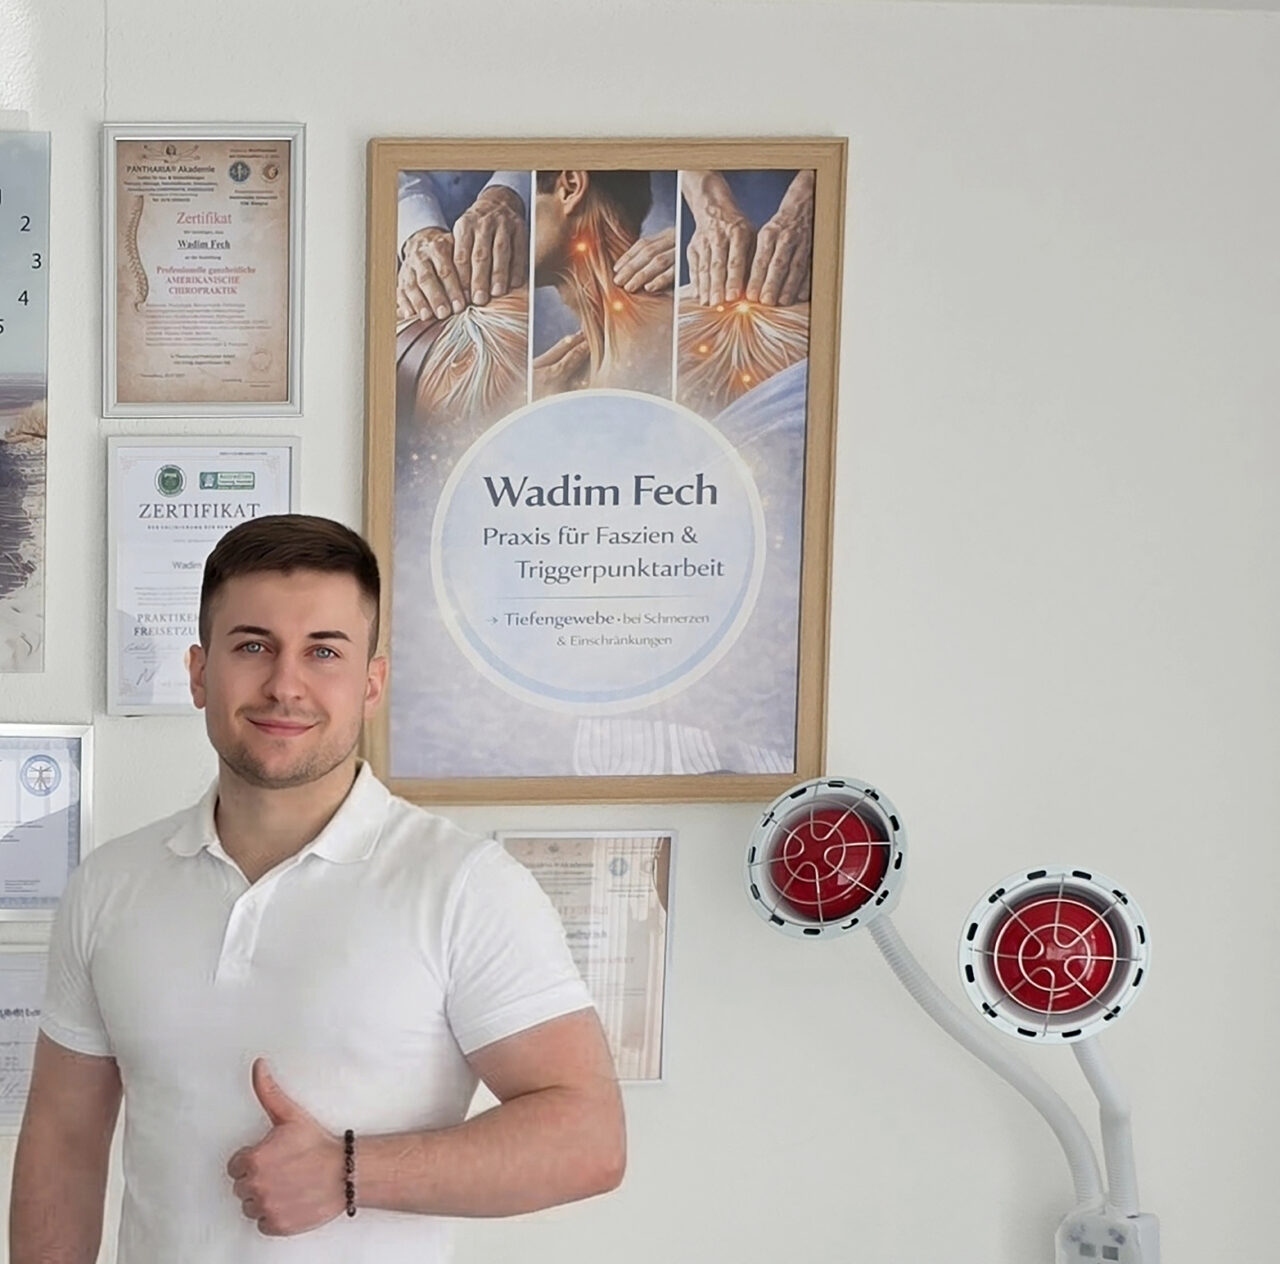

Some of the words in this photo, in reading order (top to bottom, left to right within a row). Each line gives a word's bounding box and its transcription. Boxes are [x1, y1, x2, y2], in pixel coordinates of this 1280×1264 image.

[20, 215, 31, 232] 2
[177, 212, 232, 225] Zertifikat
[177, 240, 209, 249] Wadim
[211, 240, 231, 249] Fech
[31, 253, 42, 269] 3
[18, 290, 29, 306] 4
[169, 287, 238, 295] CHIROPRAKTIK
[482, 474, 619, 507] Wadim
[633, 473, 718, 506] Fech
[138, 503, 260, 518] ZERTIFIKAT
[482, 527, 551, 546] Praxis
[558, 527, 589, 545] für
[596, 527, 674, 545] Faszien
[681, 526, 698, 544] &
[516, 558, 725, 585] Triggerpunktarbeit
[504, 611, 615, 629] Tiefengewebe
[623, 613, 641, 624] bei
[644, 612, 710, 625] Schmerzen
[557, 636, 567, 646] &
[570, 634, 673, 648] Einschränkungen
